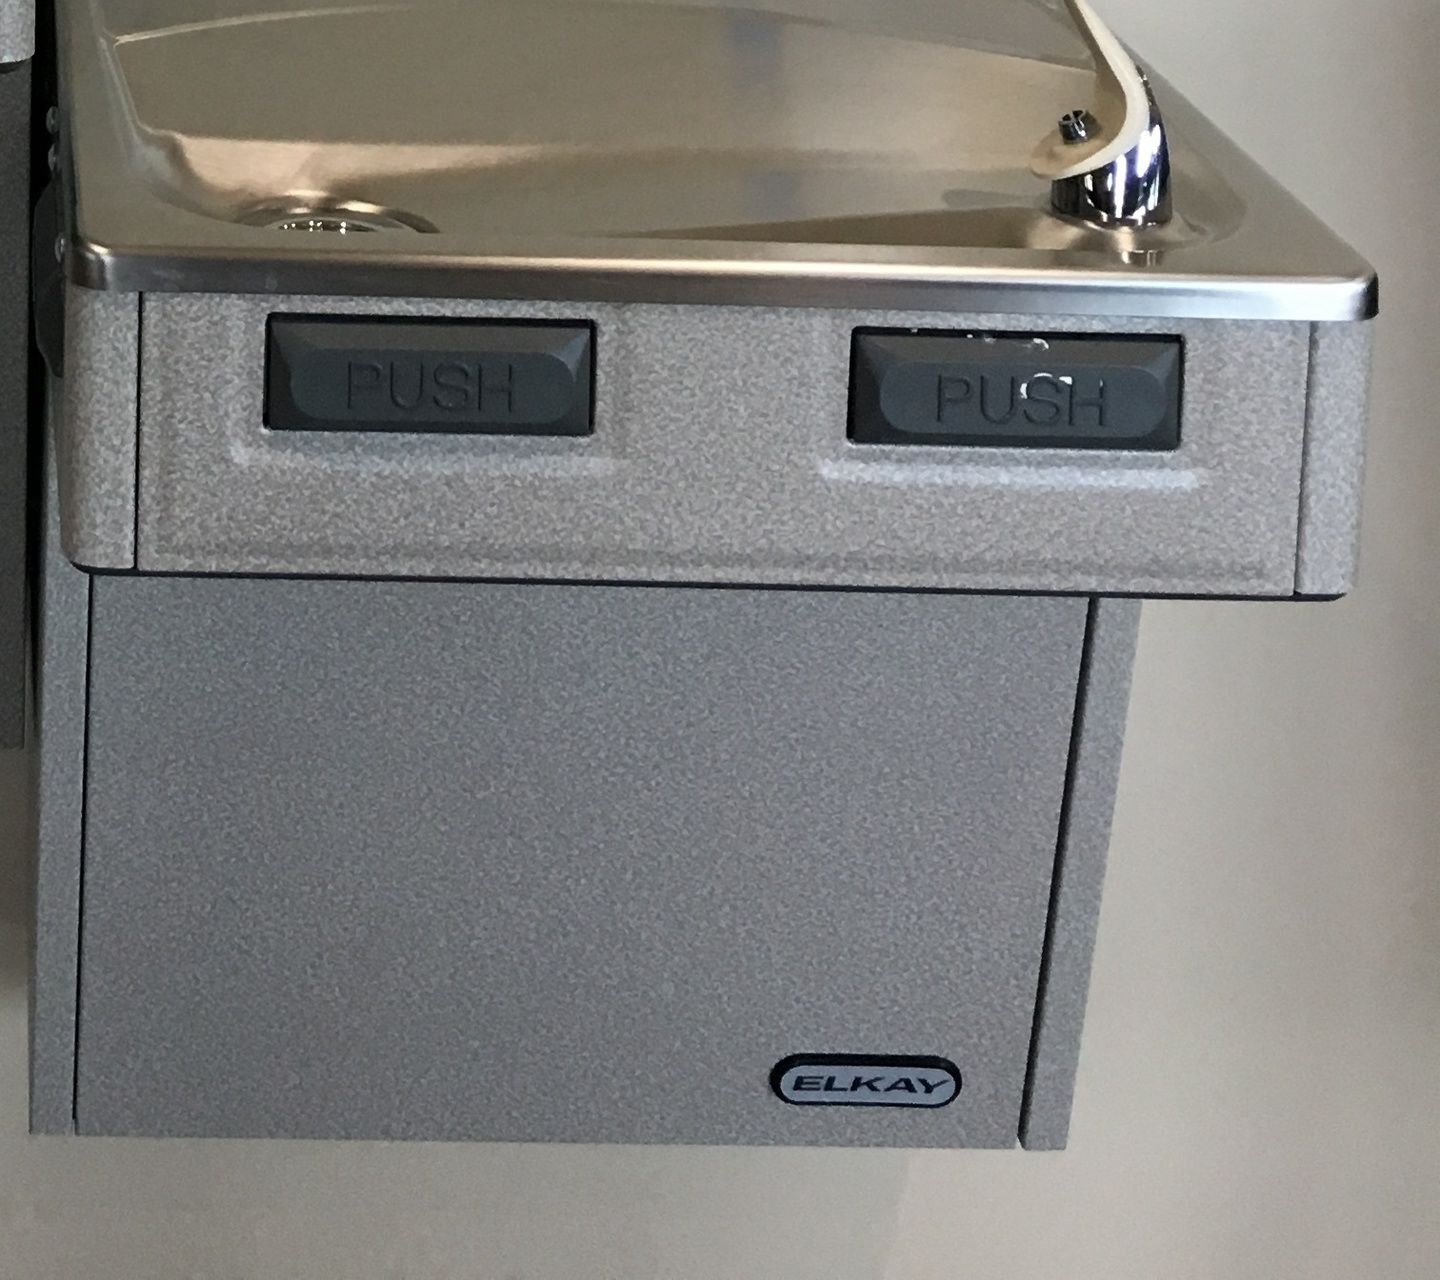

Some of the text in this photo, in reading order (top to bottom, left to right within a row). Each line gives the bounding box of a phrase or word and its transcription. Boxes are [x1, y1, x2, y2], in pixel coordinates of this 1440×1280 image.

[347, 360, 514, 412] PUSH
[936, 373, 1105, 426] PUSH
[792, 1075, 950, 1094] ELKAY
